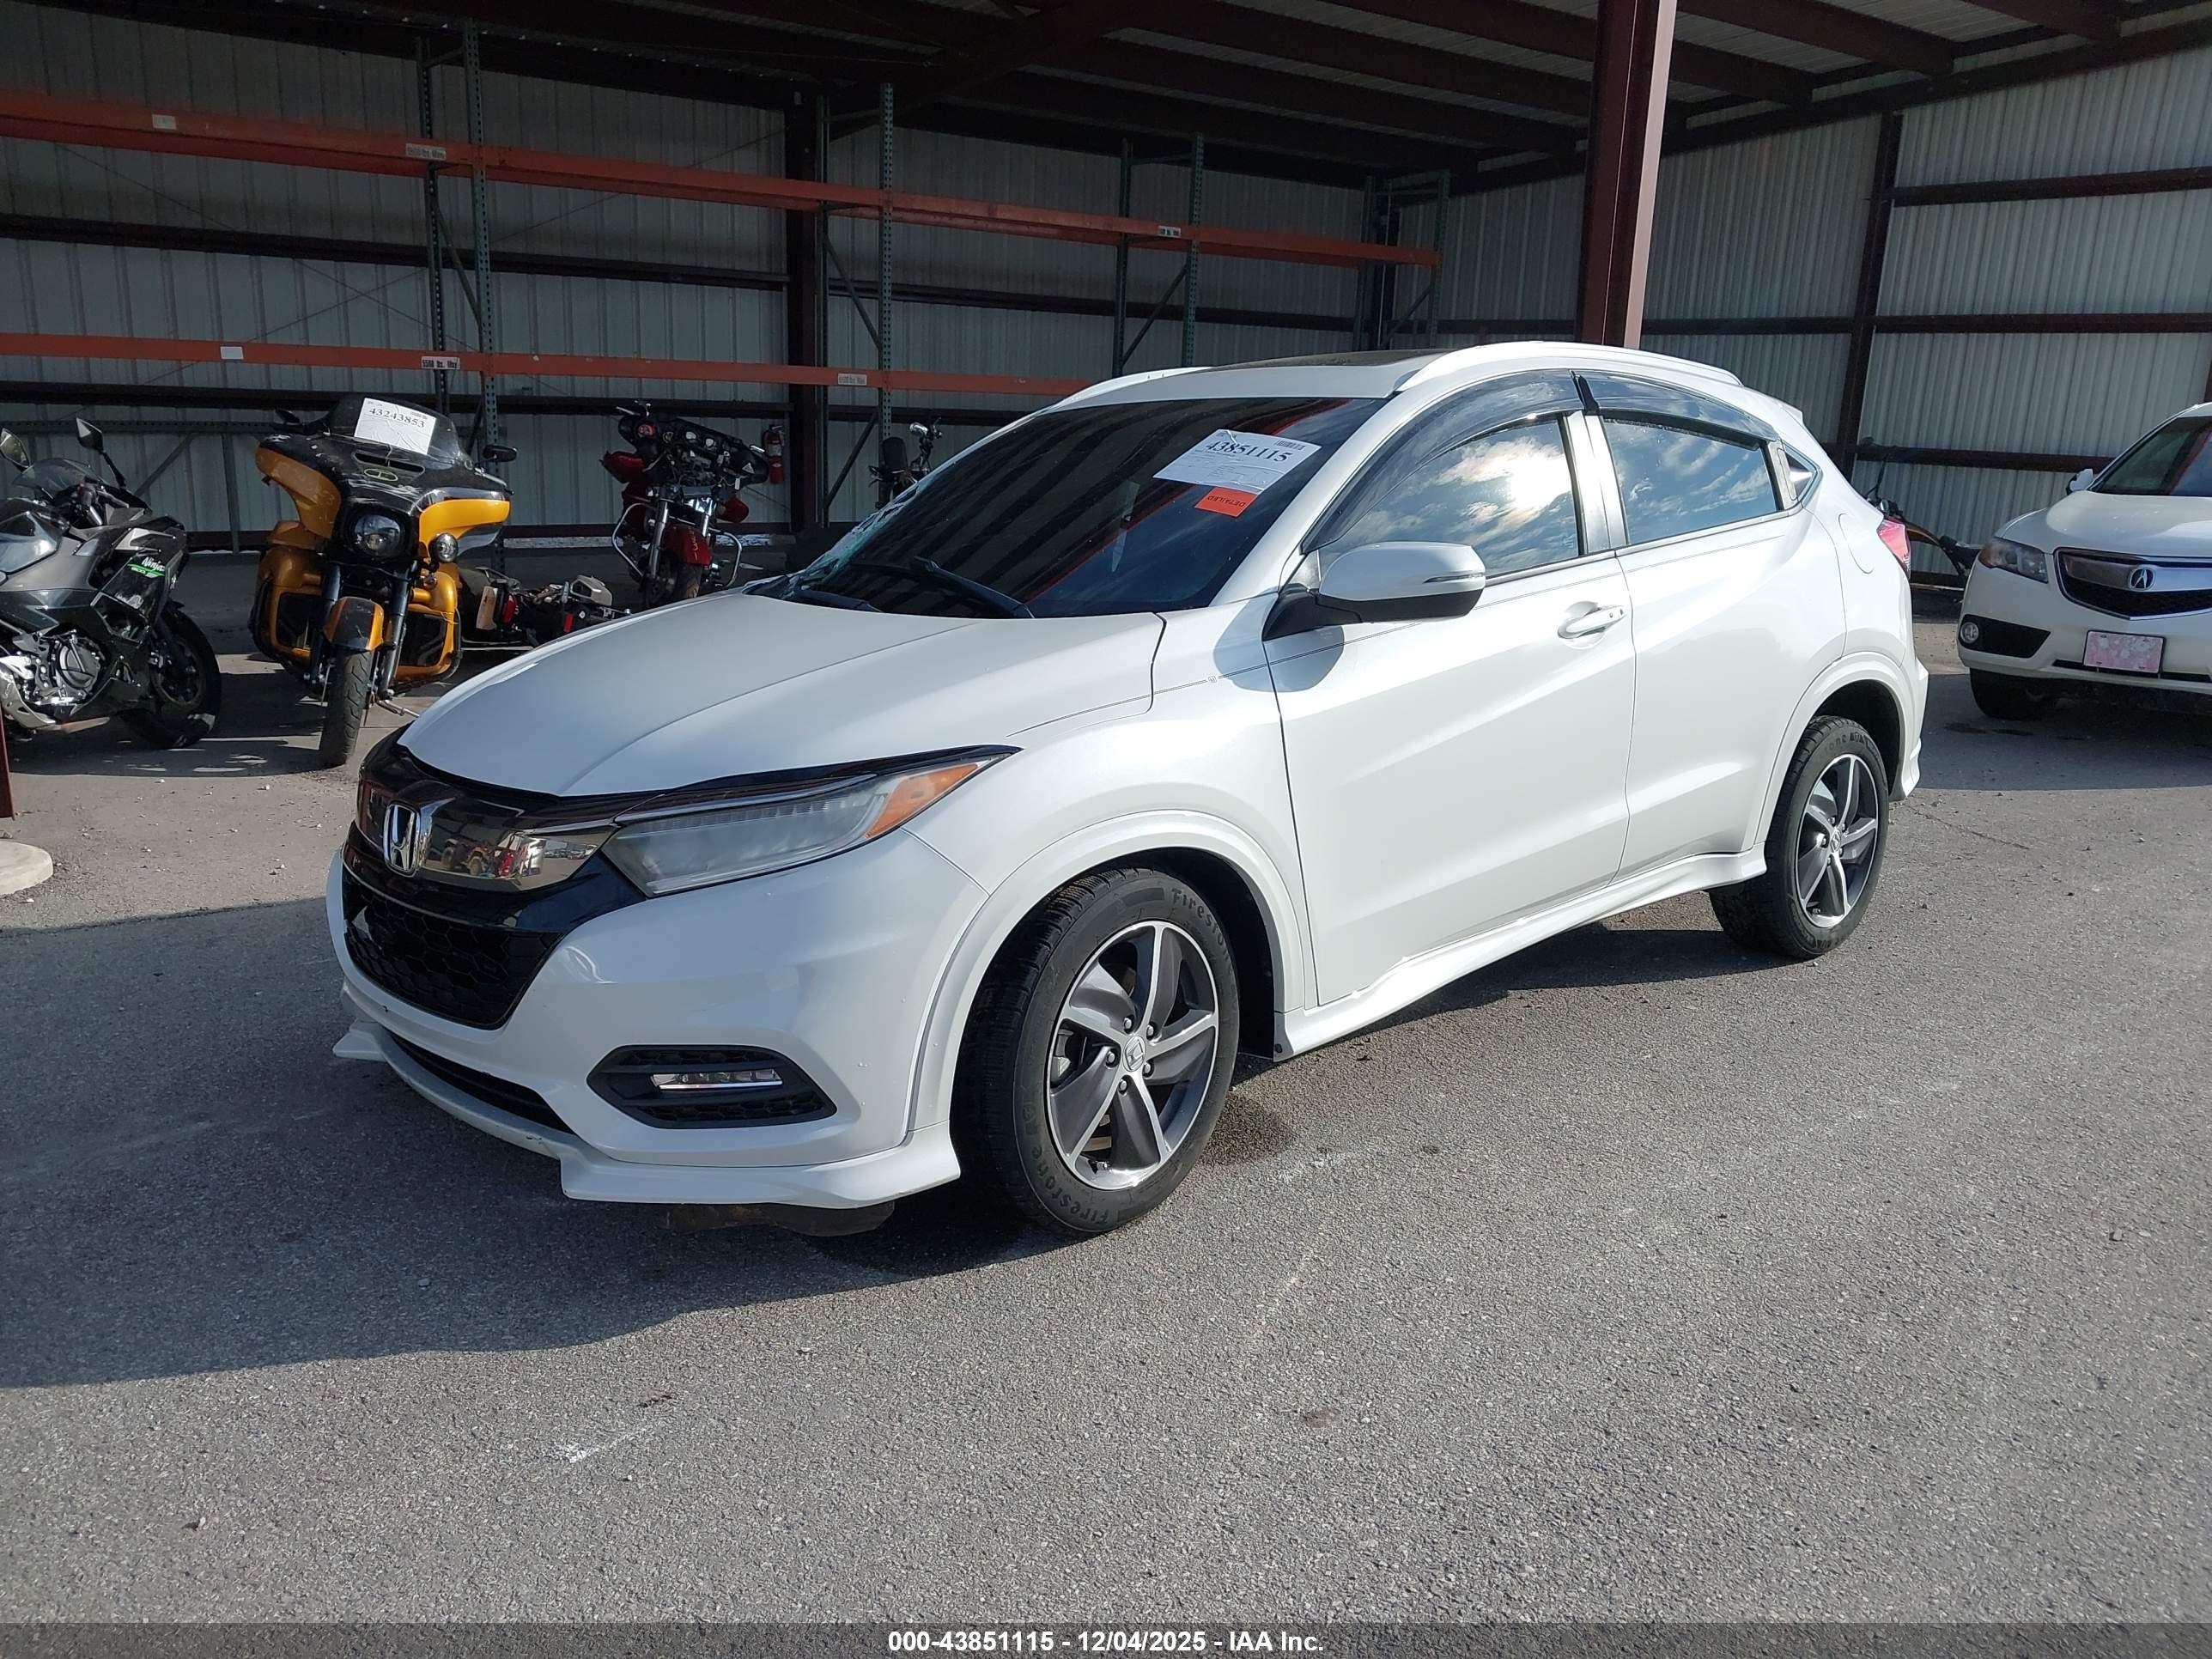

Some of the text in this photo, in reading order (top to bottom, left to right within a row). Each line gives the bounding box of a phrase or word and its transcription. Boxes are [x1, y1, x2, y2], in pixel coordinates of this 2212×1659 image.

[369, 407, 426, 428] 43243853
[1205, 440, 1295, 463] 43851115
[1206, 494, 1247, 508] DETAILED
[141, 556, 166, 572] Ninja
